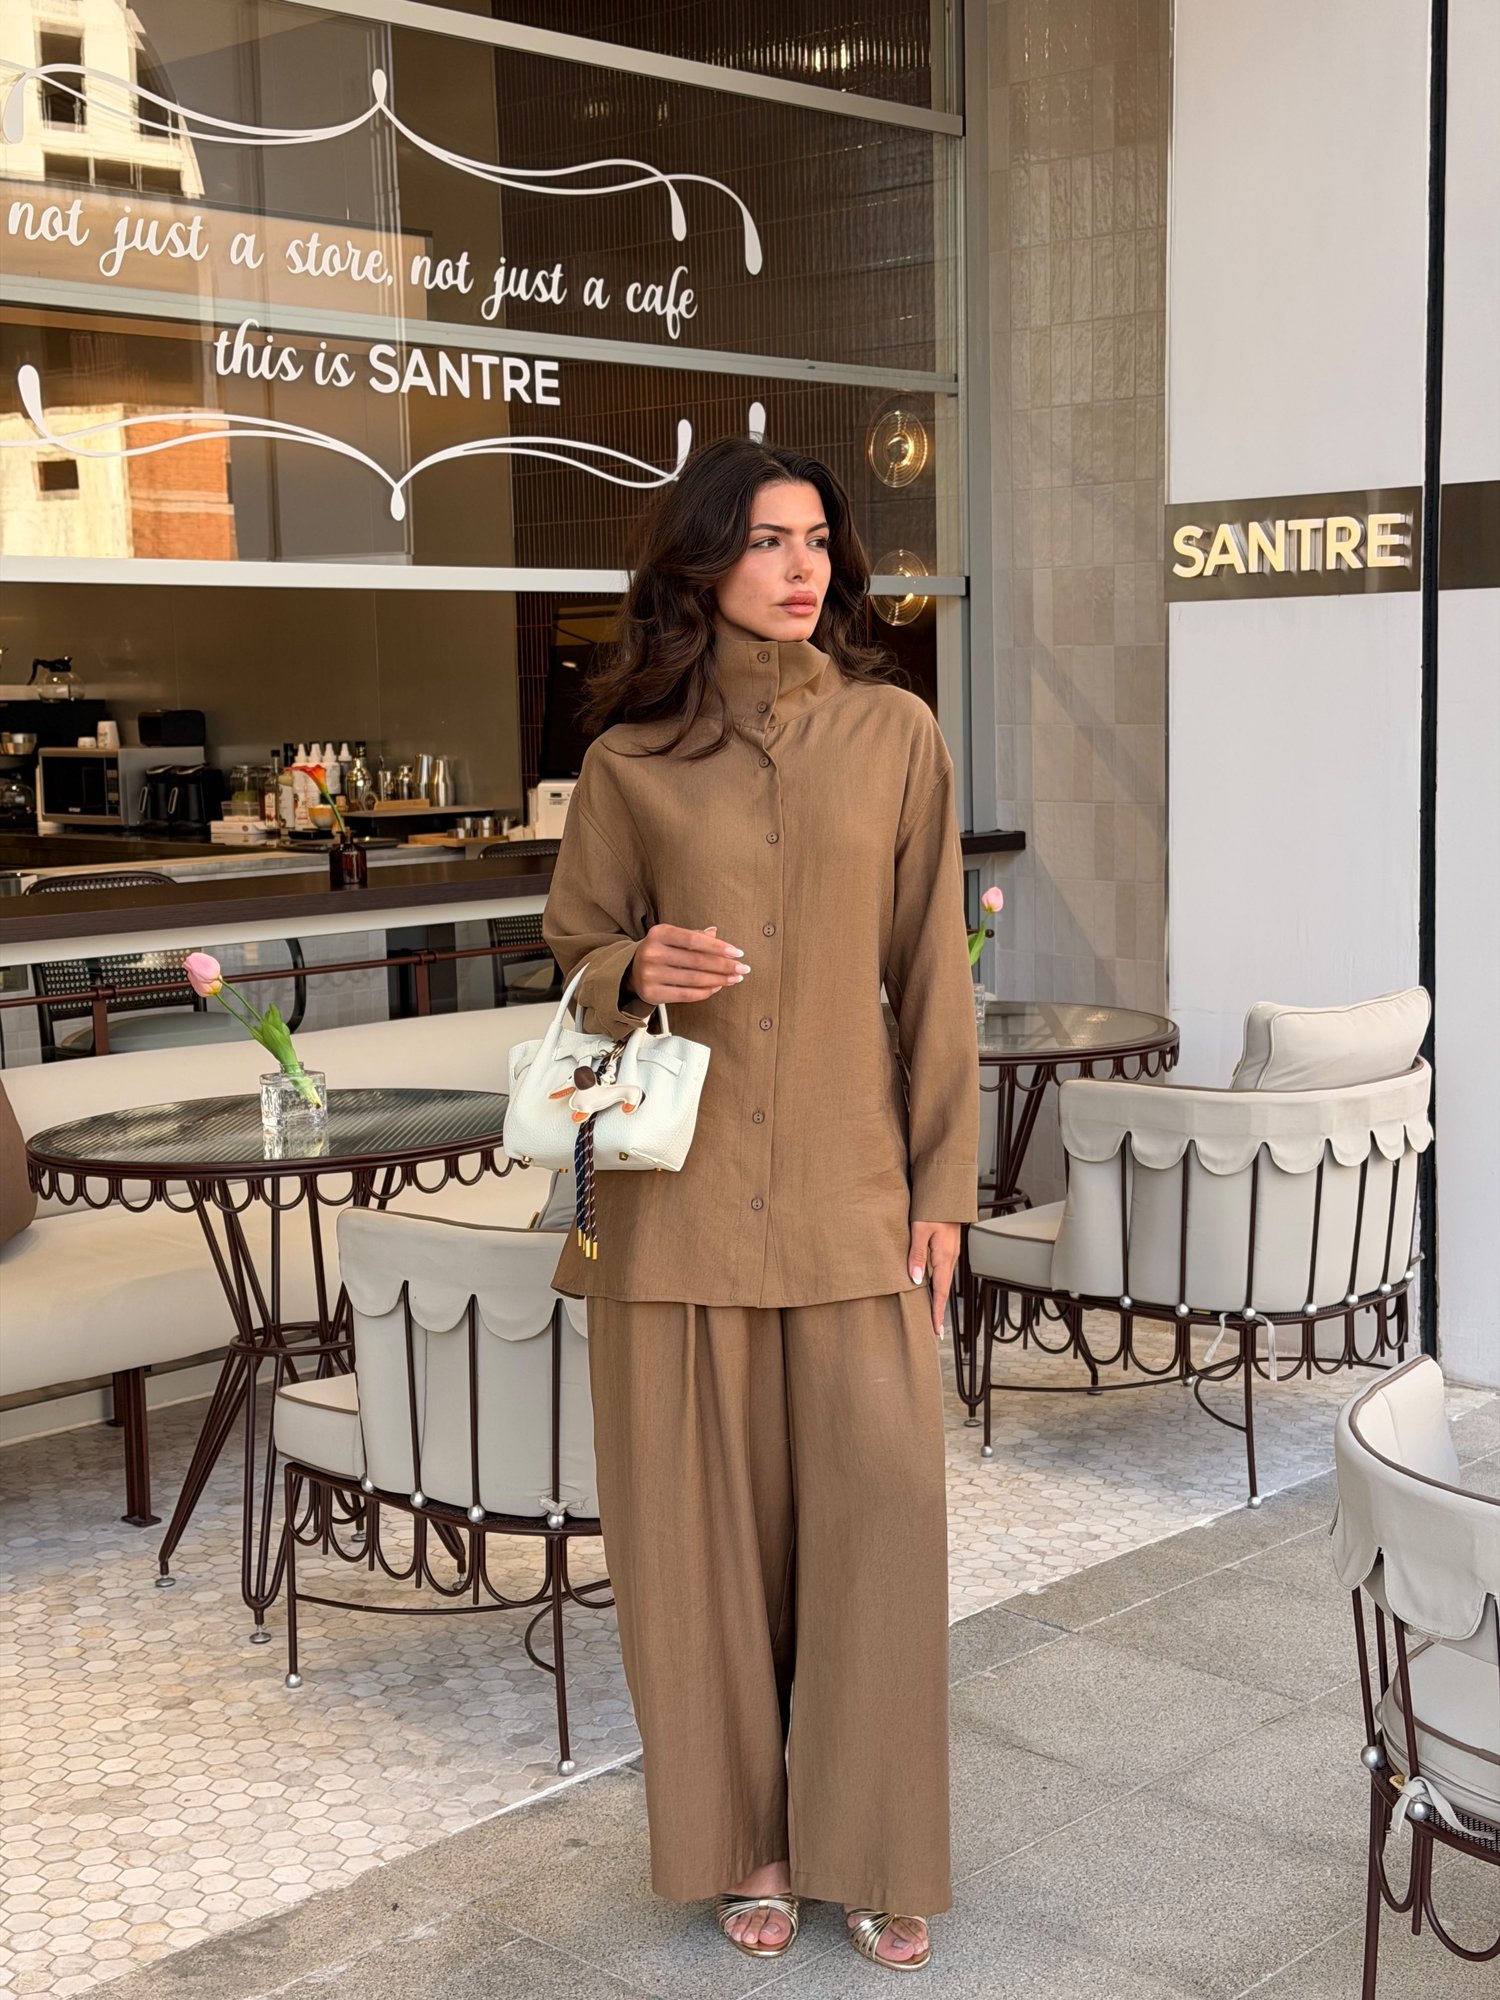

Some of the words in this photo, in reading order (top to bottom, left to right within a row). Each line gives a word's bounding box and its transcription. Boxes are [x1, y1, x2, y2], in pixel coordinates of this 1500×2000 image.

[8, 200, 89, 246] not
[100, 206, 208, 277] just
[230, 233, 264, 269] a
[286, 233, 393, 286] store,
[411, 251, 474, 294] not
[481, 257, 567, 320] just
[583, 277, 610, 309] a
[626, 266, 697, 339] cafe
[213, 319, 303, 382] this
[314, 342, 355, 387] is
[369, 343, 560, 406] SANTRE
[1172, 513, 1408, 578] SANTRE
